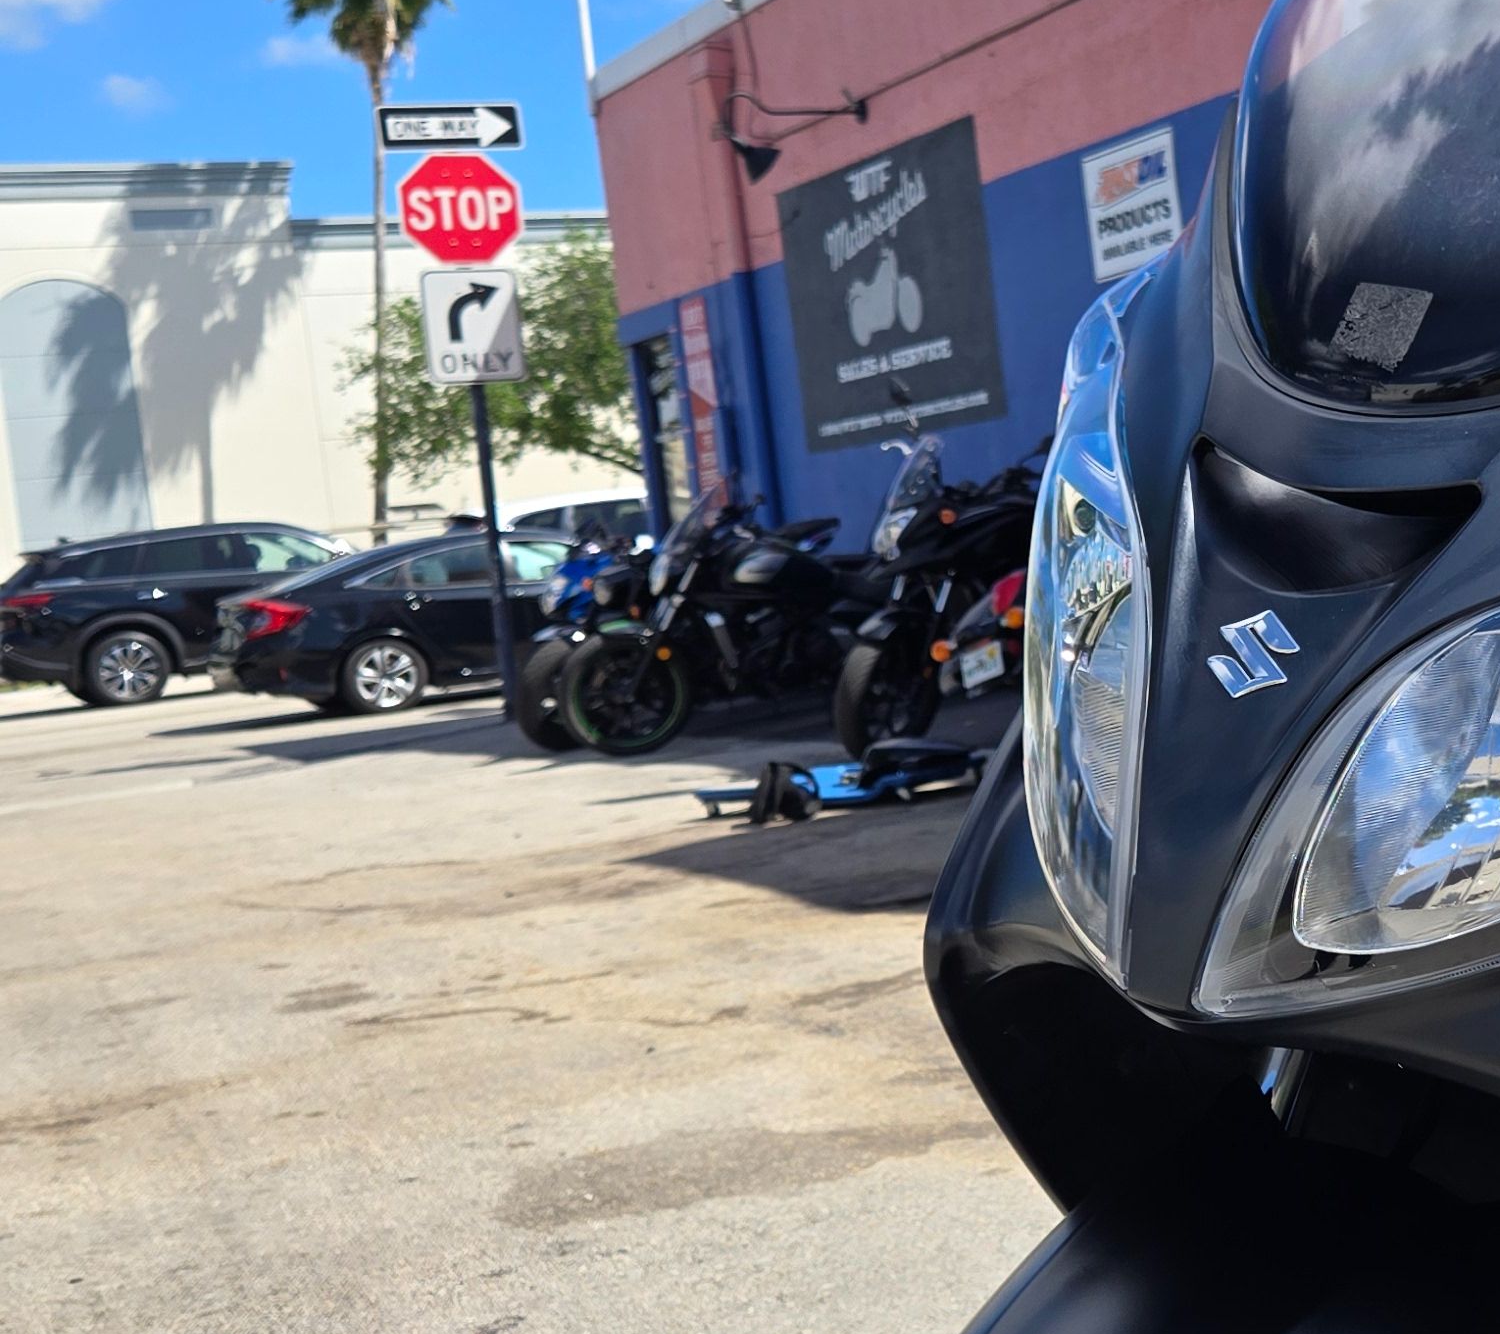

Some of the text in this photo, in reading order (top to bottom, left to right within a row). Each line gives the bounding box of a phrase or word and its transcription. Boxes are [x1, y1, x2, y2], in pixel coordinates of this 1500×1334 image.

[393, 119, 479, 138] ONE WAY
[407, 188, 513, 232] STOP
[1097, 197, 1172, 239] PRODUCTS
[441, 351, 514, 374] ONLY
